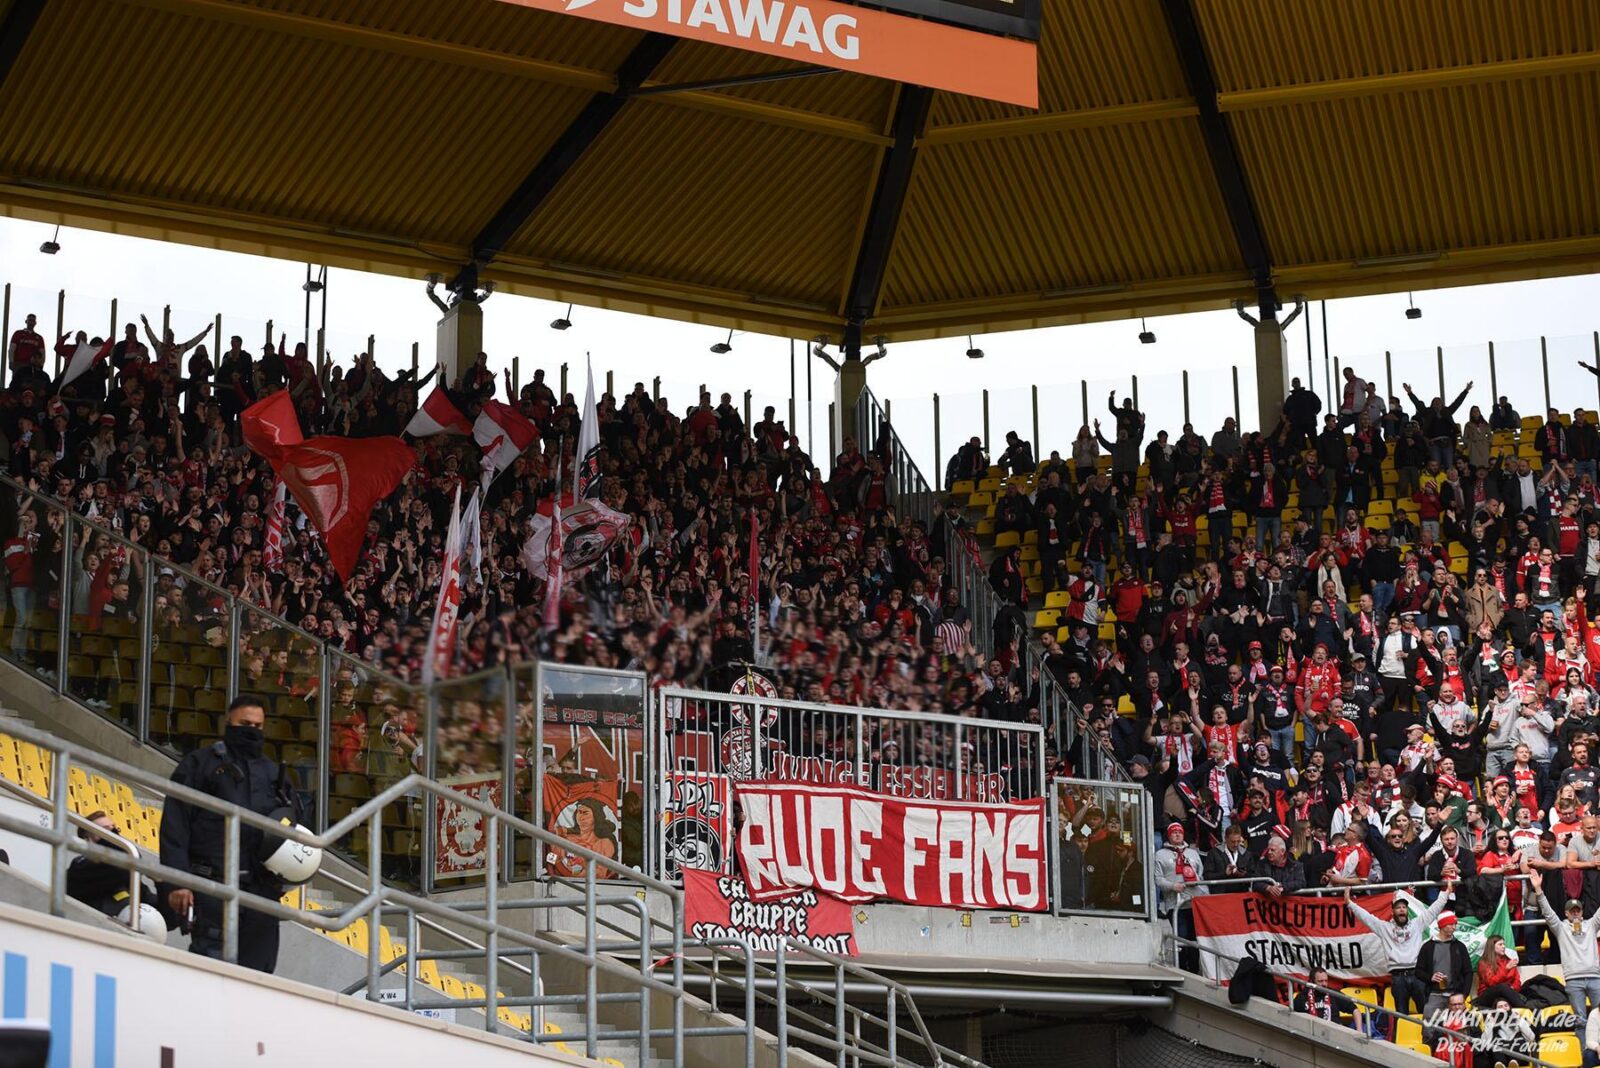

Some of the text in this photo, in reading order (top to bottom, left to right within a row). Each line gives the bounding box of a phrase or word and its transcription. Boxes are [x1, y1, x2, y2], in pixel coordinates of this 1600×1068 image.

[762, 750, 874, 787] JUNGE
[738, 793, 1040, 909] RUDE FANS
[1242, 898, 1356, 930] EVOLUTION
[1244, 939, 1364, 970] STADTWALD
